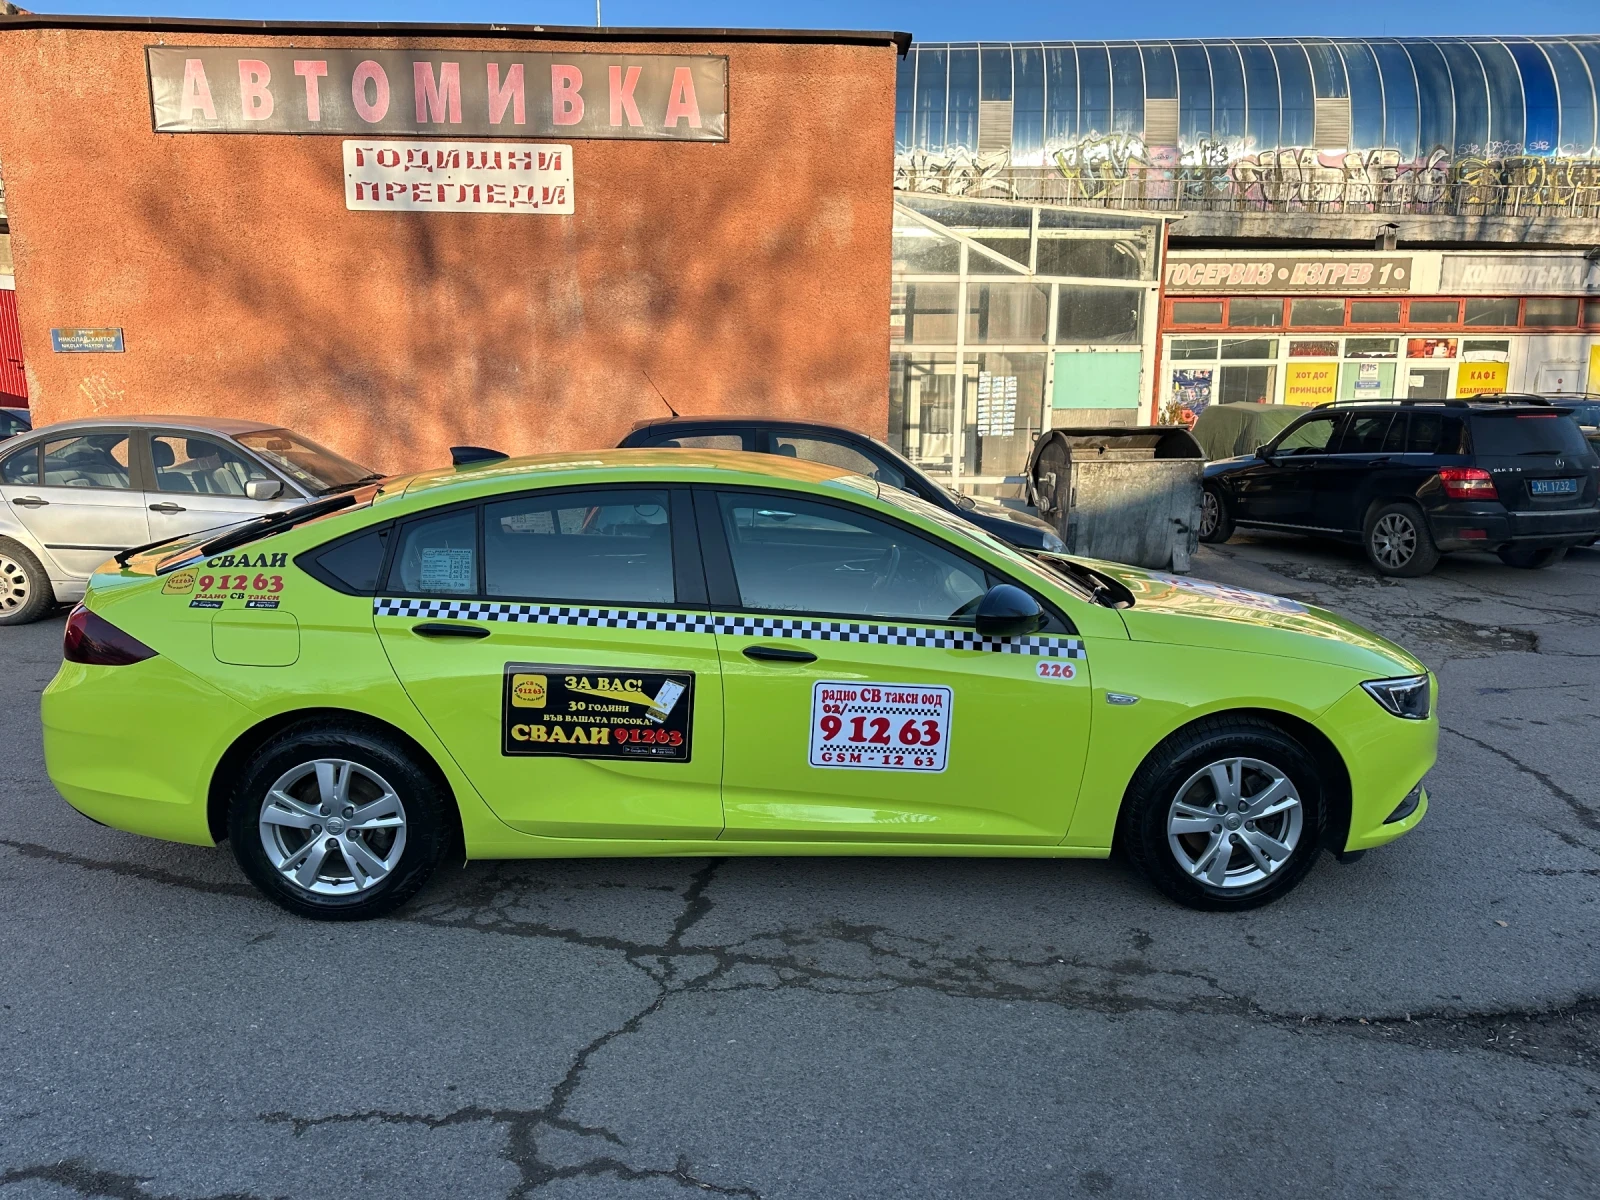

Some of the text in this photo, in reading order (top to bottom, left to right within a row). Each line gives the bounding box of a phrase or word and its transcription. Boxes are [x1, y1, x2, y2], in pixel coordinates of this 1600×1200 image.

[179, 58, 702, 129] АВТОМИВКА
[355, 147, 562, 173] ГОДИШНИ
[355, 181, 567, 208] ПРЕГЛЕДИ
[1289, 263, 1374, 285] ИЗГРЕВ
[1379, 263, 1393, 285] 1
[1296, 371, 1328, 380] ХОТ ДОГ
[1470, 371, 1496, 380] КАФЕ
[1290, 386, 1332, 394] ПРИНЦЕСИ
[1551, 481, 1570, 491] 1732
[206, 553, 288, 568] СВАЛИ
[1039, 663, 1074, 679] 226
[564, 676, 643, 693] ЗА ВАС!
[822, 688, 943, 709] радио СВ такси оод
[568, 701, 630, 713] 30 ГОДИНИ
[543, 714, 564, 722] ВЪВ
[565, 714, 608, 724] ВАШАТА
[511, 724, 684, 747] СВАЛИ 91263
[821, 752, 862, 764] GSM
